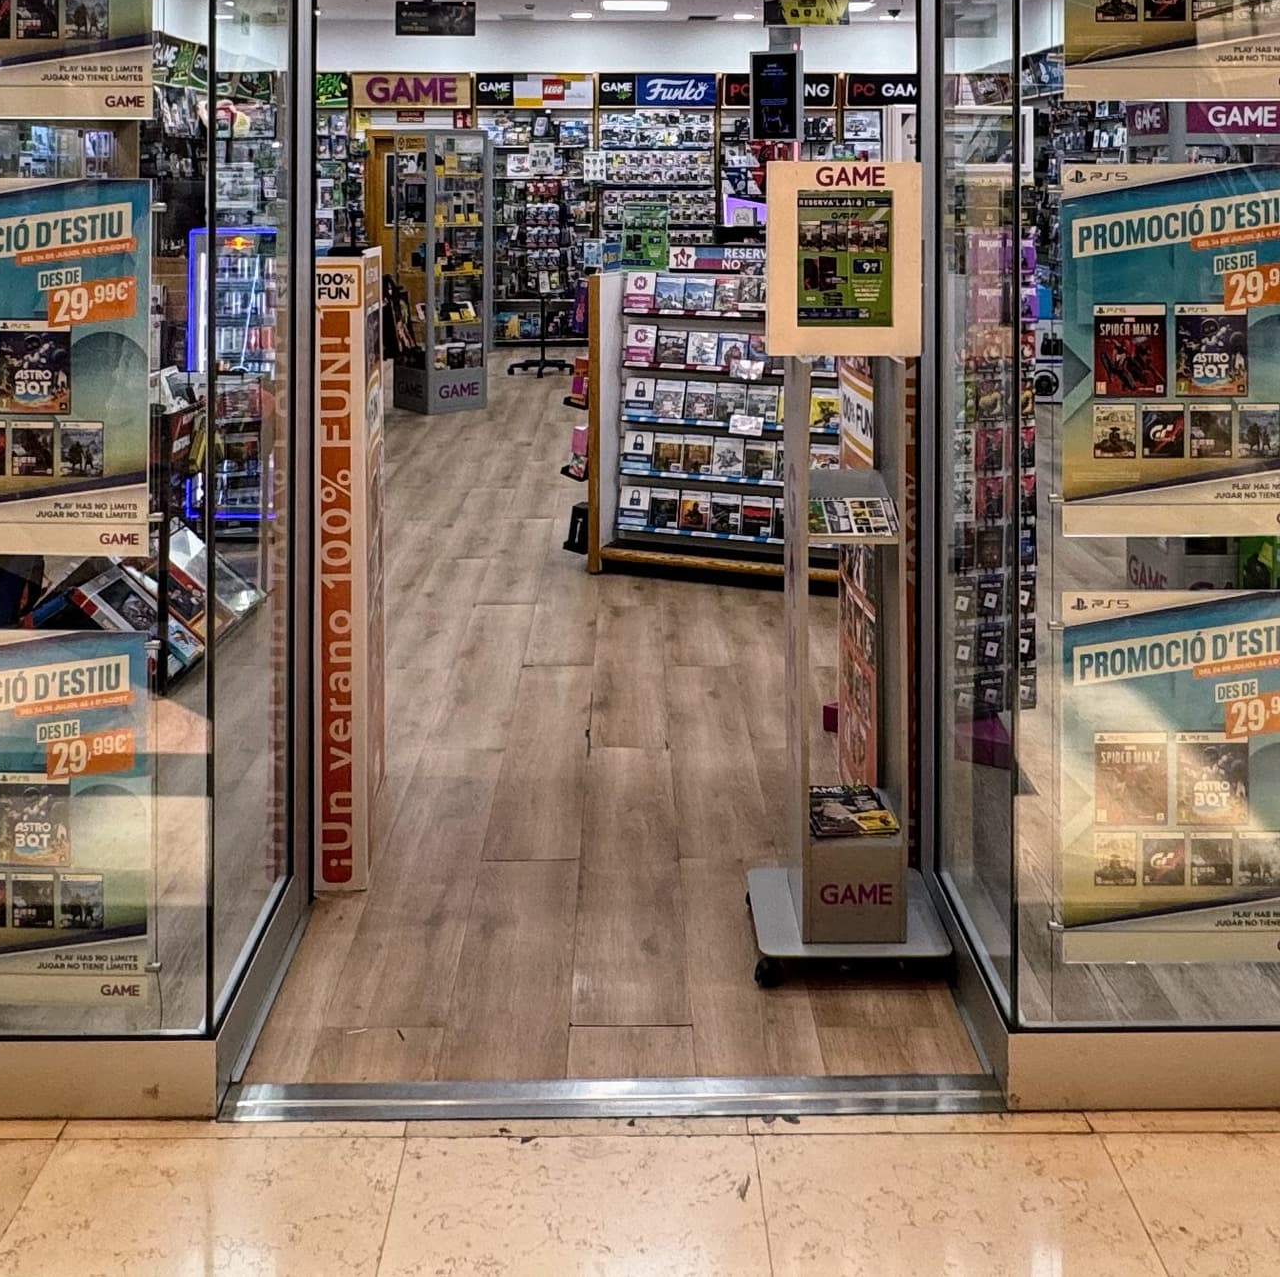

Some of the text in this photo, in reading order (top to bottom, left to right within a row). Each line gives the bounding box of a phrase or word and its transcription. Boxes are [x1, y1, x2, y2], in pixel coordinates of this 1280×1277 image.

[365, 76, 458, 103] GAME
[478, 82, 511, 92] GAME
[544, 83, 564, 96] LEGO
[601, 82, 633, 93] GAME
[645, 77, 710, 102] Funko
[853, 83, 917, 97] PC GAM
[104, 94, 145, 108] GAME
[1134, 107, 1161, 130] GAME
[1207, 106, 1277, 127] GAME
[815, 167, 886, 187] GAME
[1092, 170, 1131, 181] PS5
[35, 211, 124, 249] D'ESTIU
[1078, 204, 1206, 252] PROMOCIÓ
[1215, 253, 1256, 273] DES DE
[40, 269, 81, 289] DES DE
[316, 272, 355, 286] 100%
[317, 286, 351, 300] FUN
[1191, 352, 1230, 363] ASTRO
[14, 369, 53, 380] ASTRO
[1192, 363, 1228, 379] BOT
[15, 381, 52, 396] BOT
[438, 381, 480, 401] GAME
[94, 502, 108, 510] NO
[35, 511, 65, 519] JUGAR
[99, 533, 139, 546] GAME
[320, 336, 353, 867] ¡Un verano 100% FUN!
[1093, 598, 1132, 609] PS5
[1079, 632, 1207, 680] PROMOCIÓ
[33, 663, 122, 701] D'ESTIU
[819, 883, 893, 906] GAME
[100, 984, 140, 997] GAME
